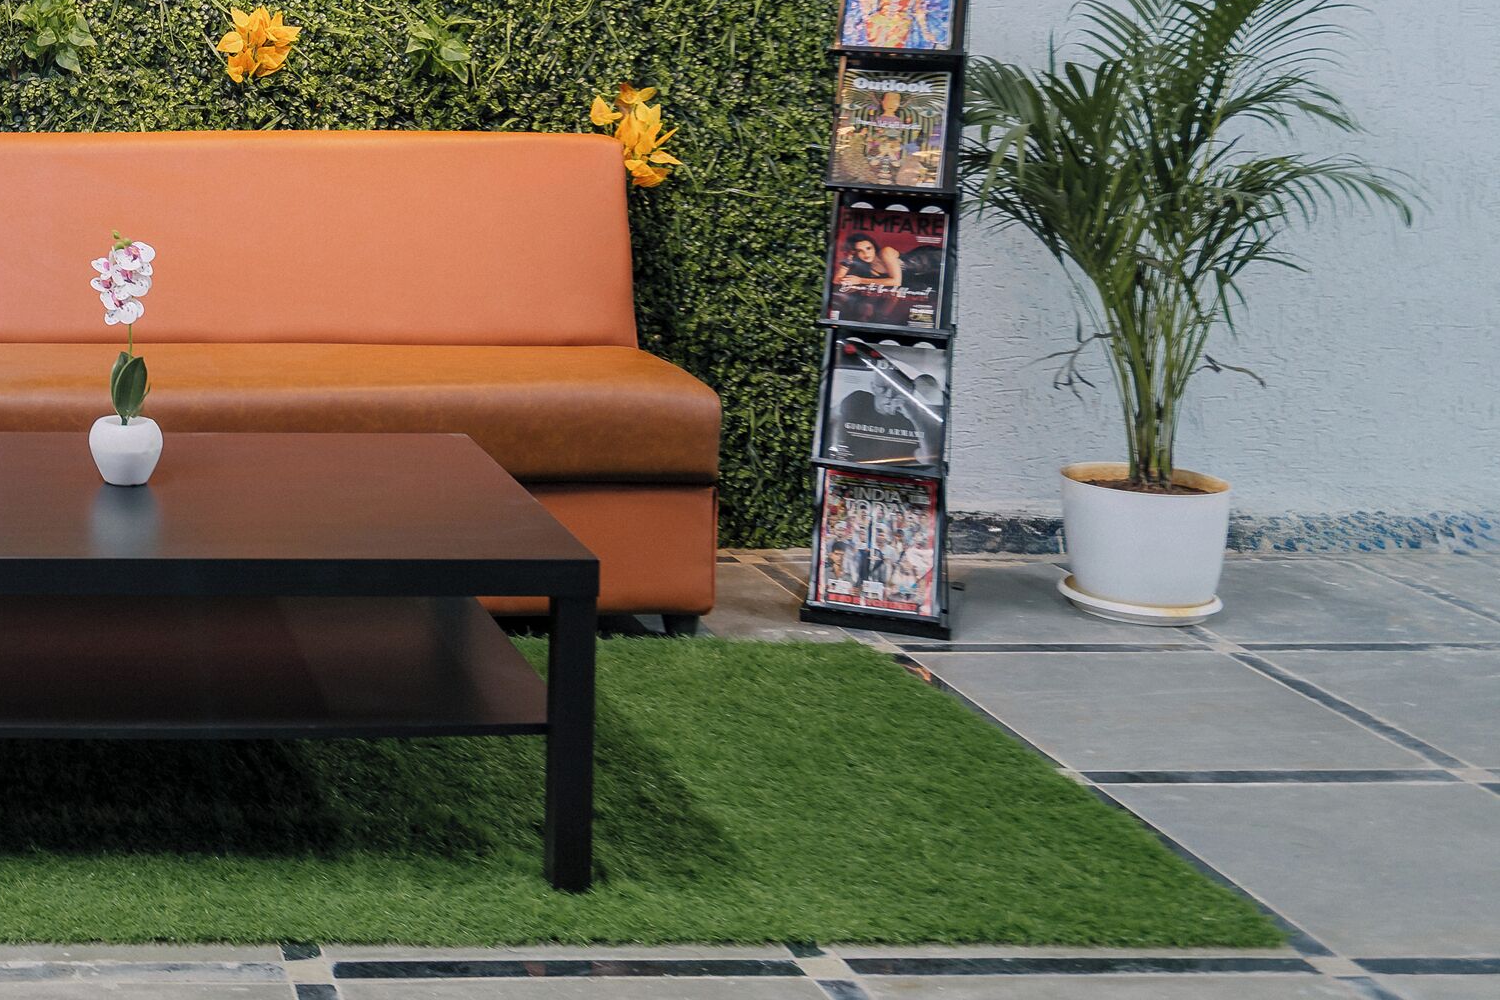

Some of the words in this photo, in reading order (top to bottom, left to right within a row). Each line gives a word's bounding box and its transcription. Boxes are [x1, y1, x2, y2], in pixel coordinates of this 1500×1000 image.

[852, 76, 933, 93] Outlook
[841, 211, 944, 236] FILMFARE
[844, 421, 886, 434] GIORGIO
[853, 487, 903, 504] INDIA
[844, 497, 909, 516] TODAY
